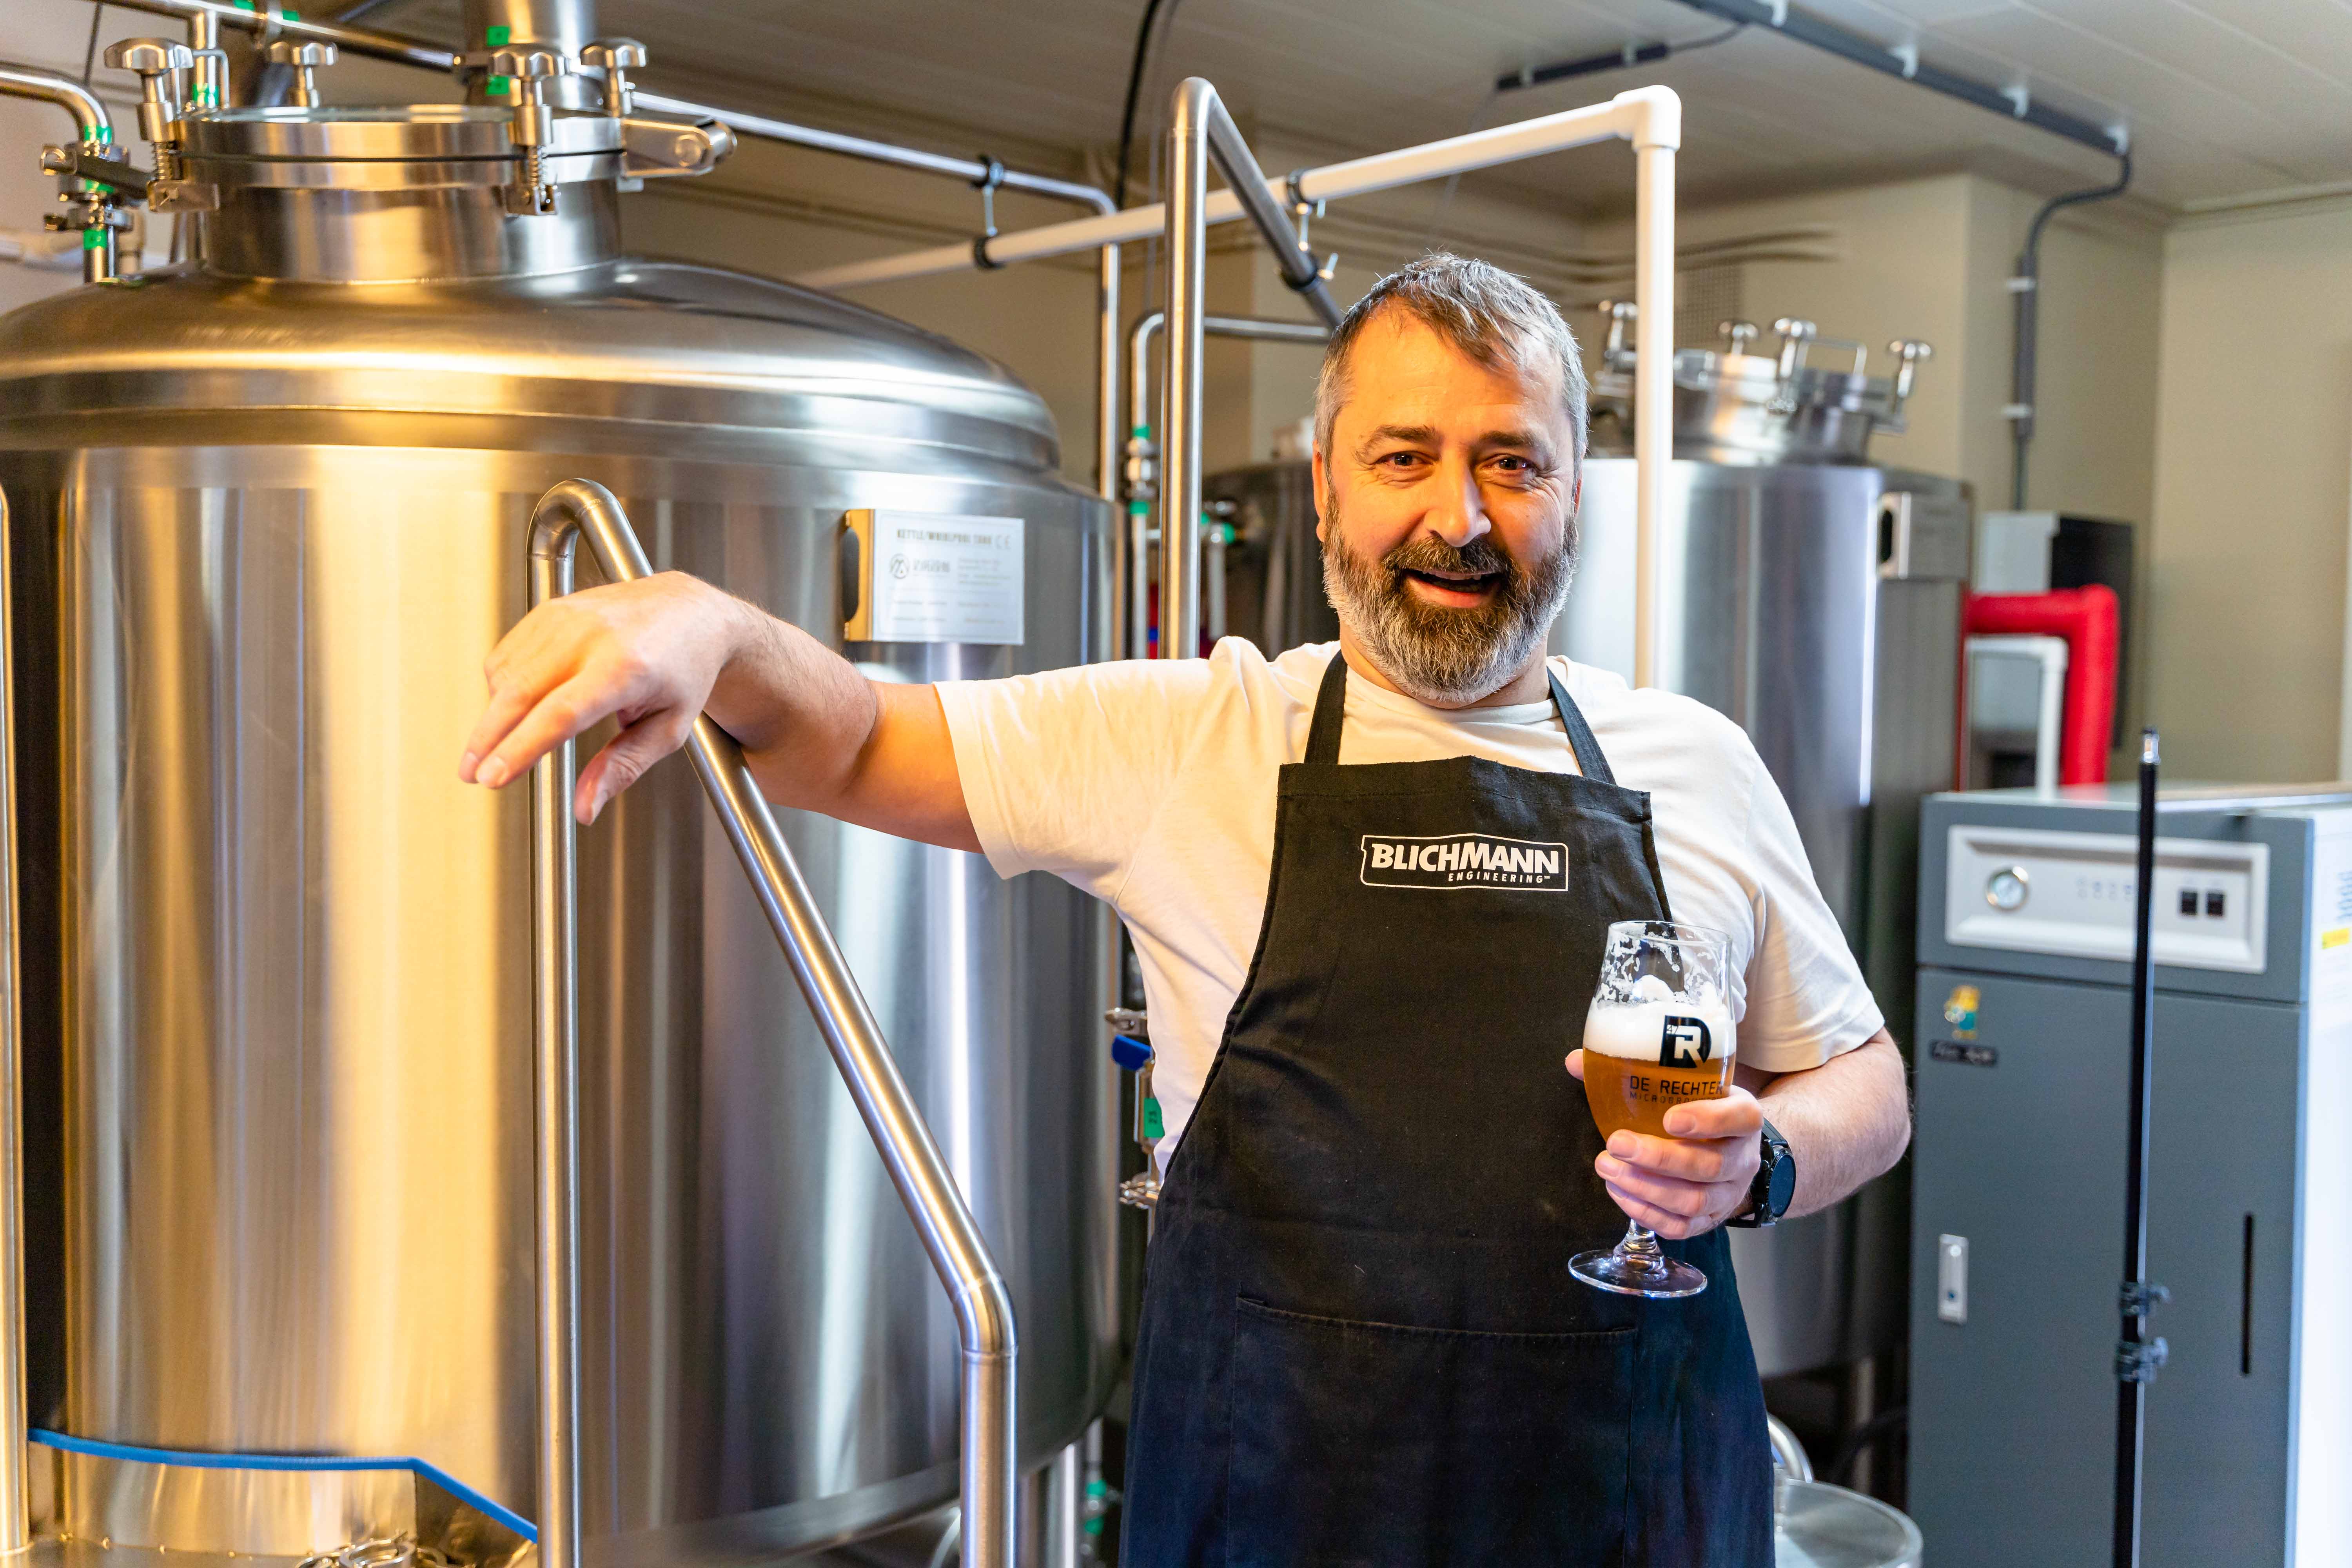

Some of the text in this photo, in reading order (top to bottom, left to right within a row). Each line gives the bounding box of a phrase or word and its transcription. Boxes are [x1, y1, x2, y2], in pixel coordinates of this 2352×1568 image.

[1372, 842, 1559, 874] BLICHMANN
[1630, 1075, 1723, 1095] DE RECHTER
